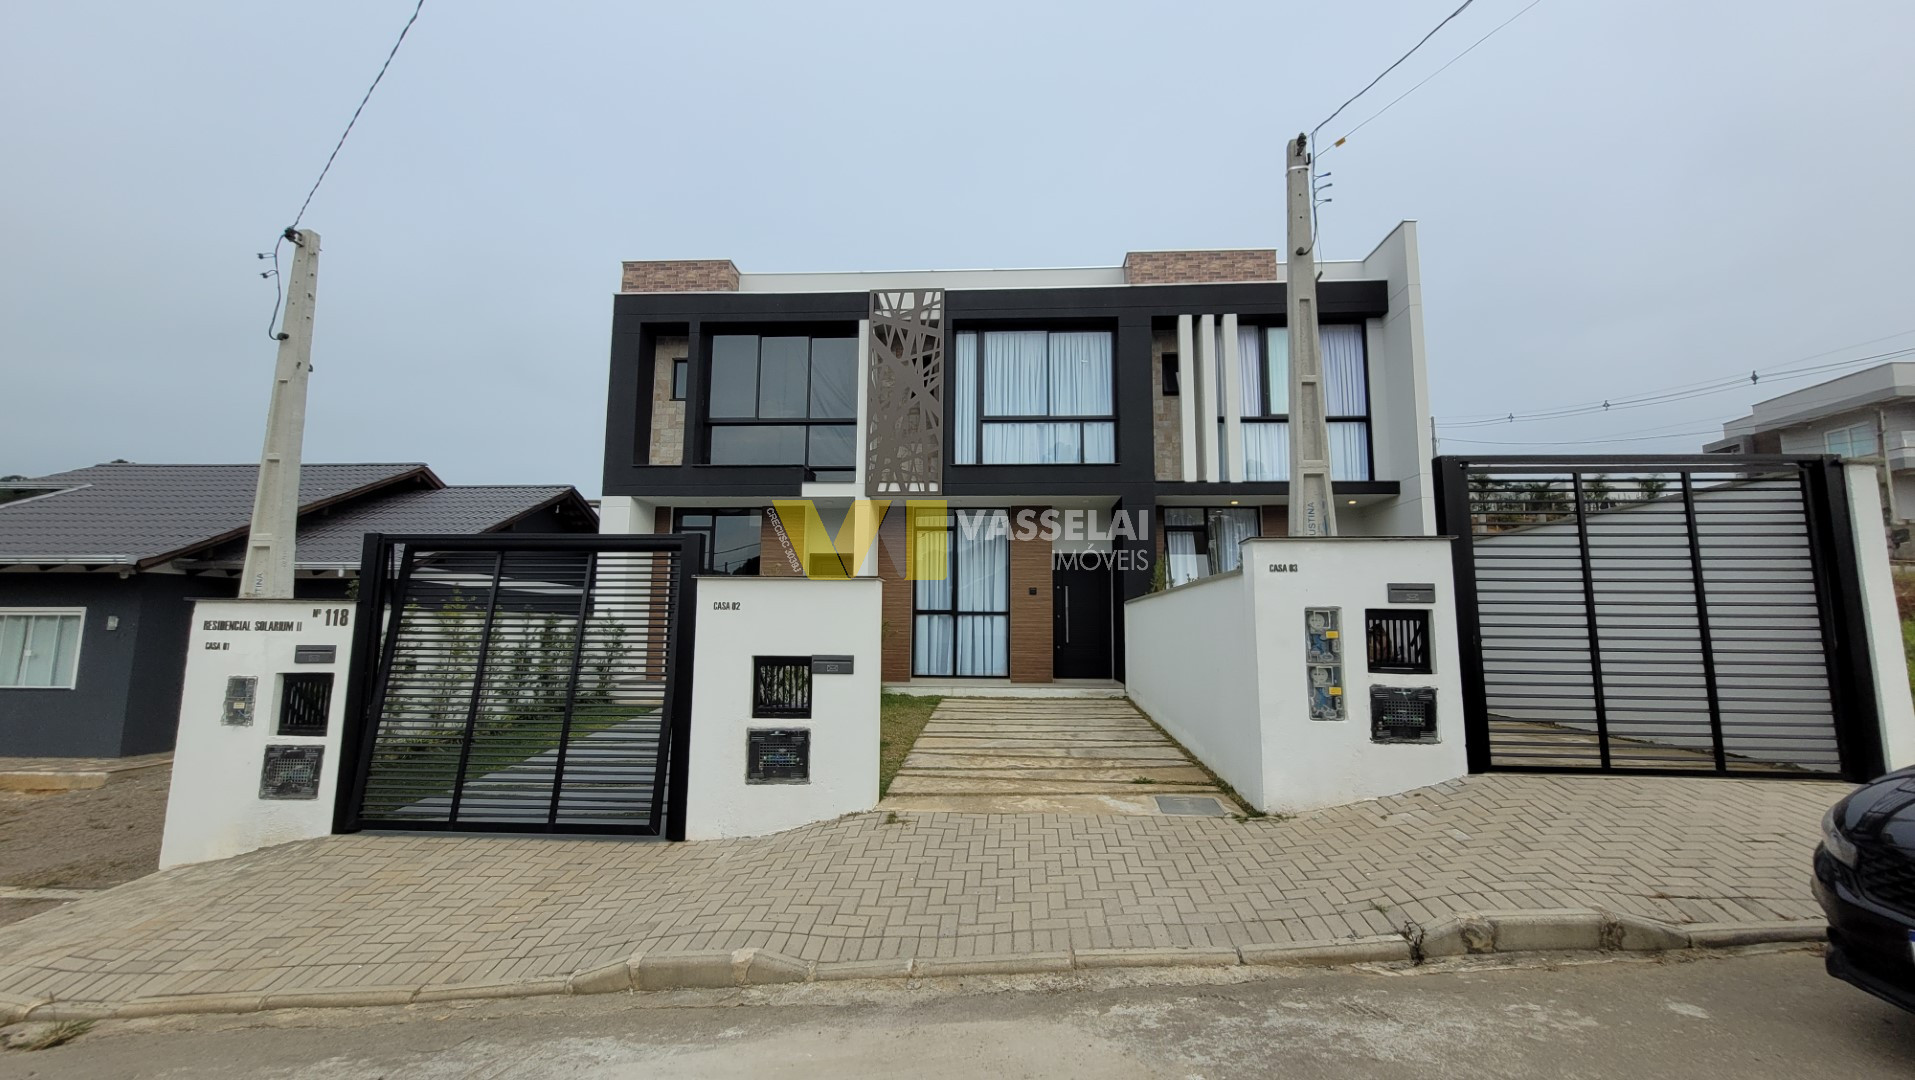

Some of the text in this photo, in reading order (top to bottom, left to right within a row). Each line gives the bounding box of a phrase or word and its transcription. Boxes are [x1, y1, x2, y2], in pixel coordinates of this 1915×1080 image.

[1269, 564, 1298, 573] CASA 03
[713, 601, 741, 611] CASA 02
[325, 608, 350, 627] 118
[203, 620, 251, 631] RESIDENCIAL
[254, 620, 294, 632] SOLARIUM
[205, 641, 230, 651] CASA 01
